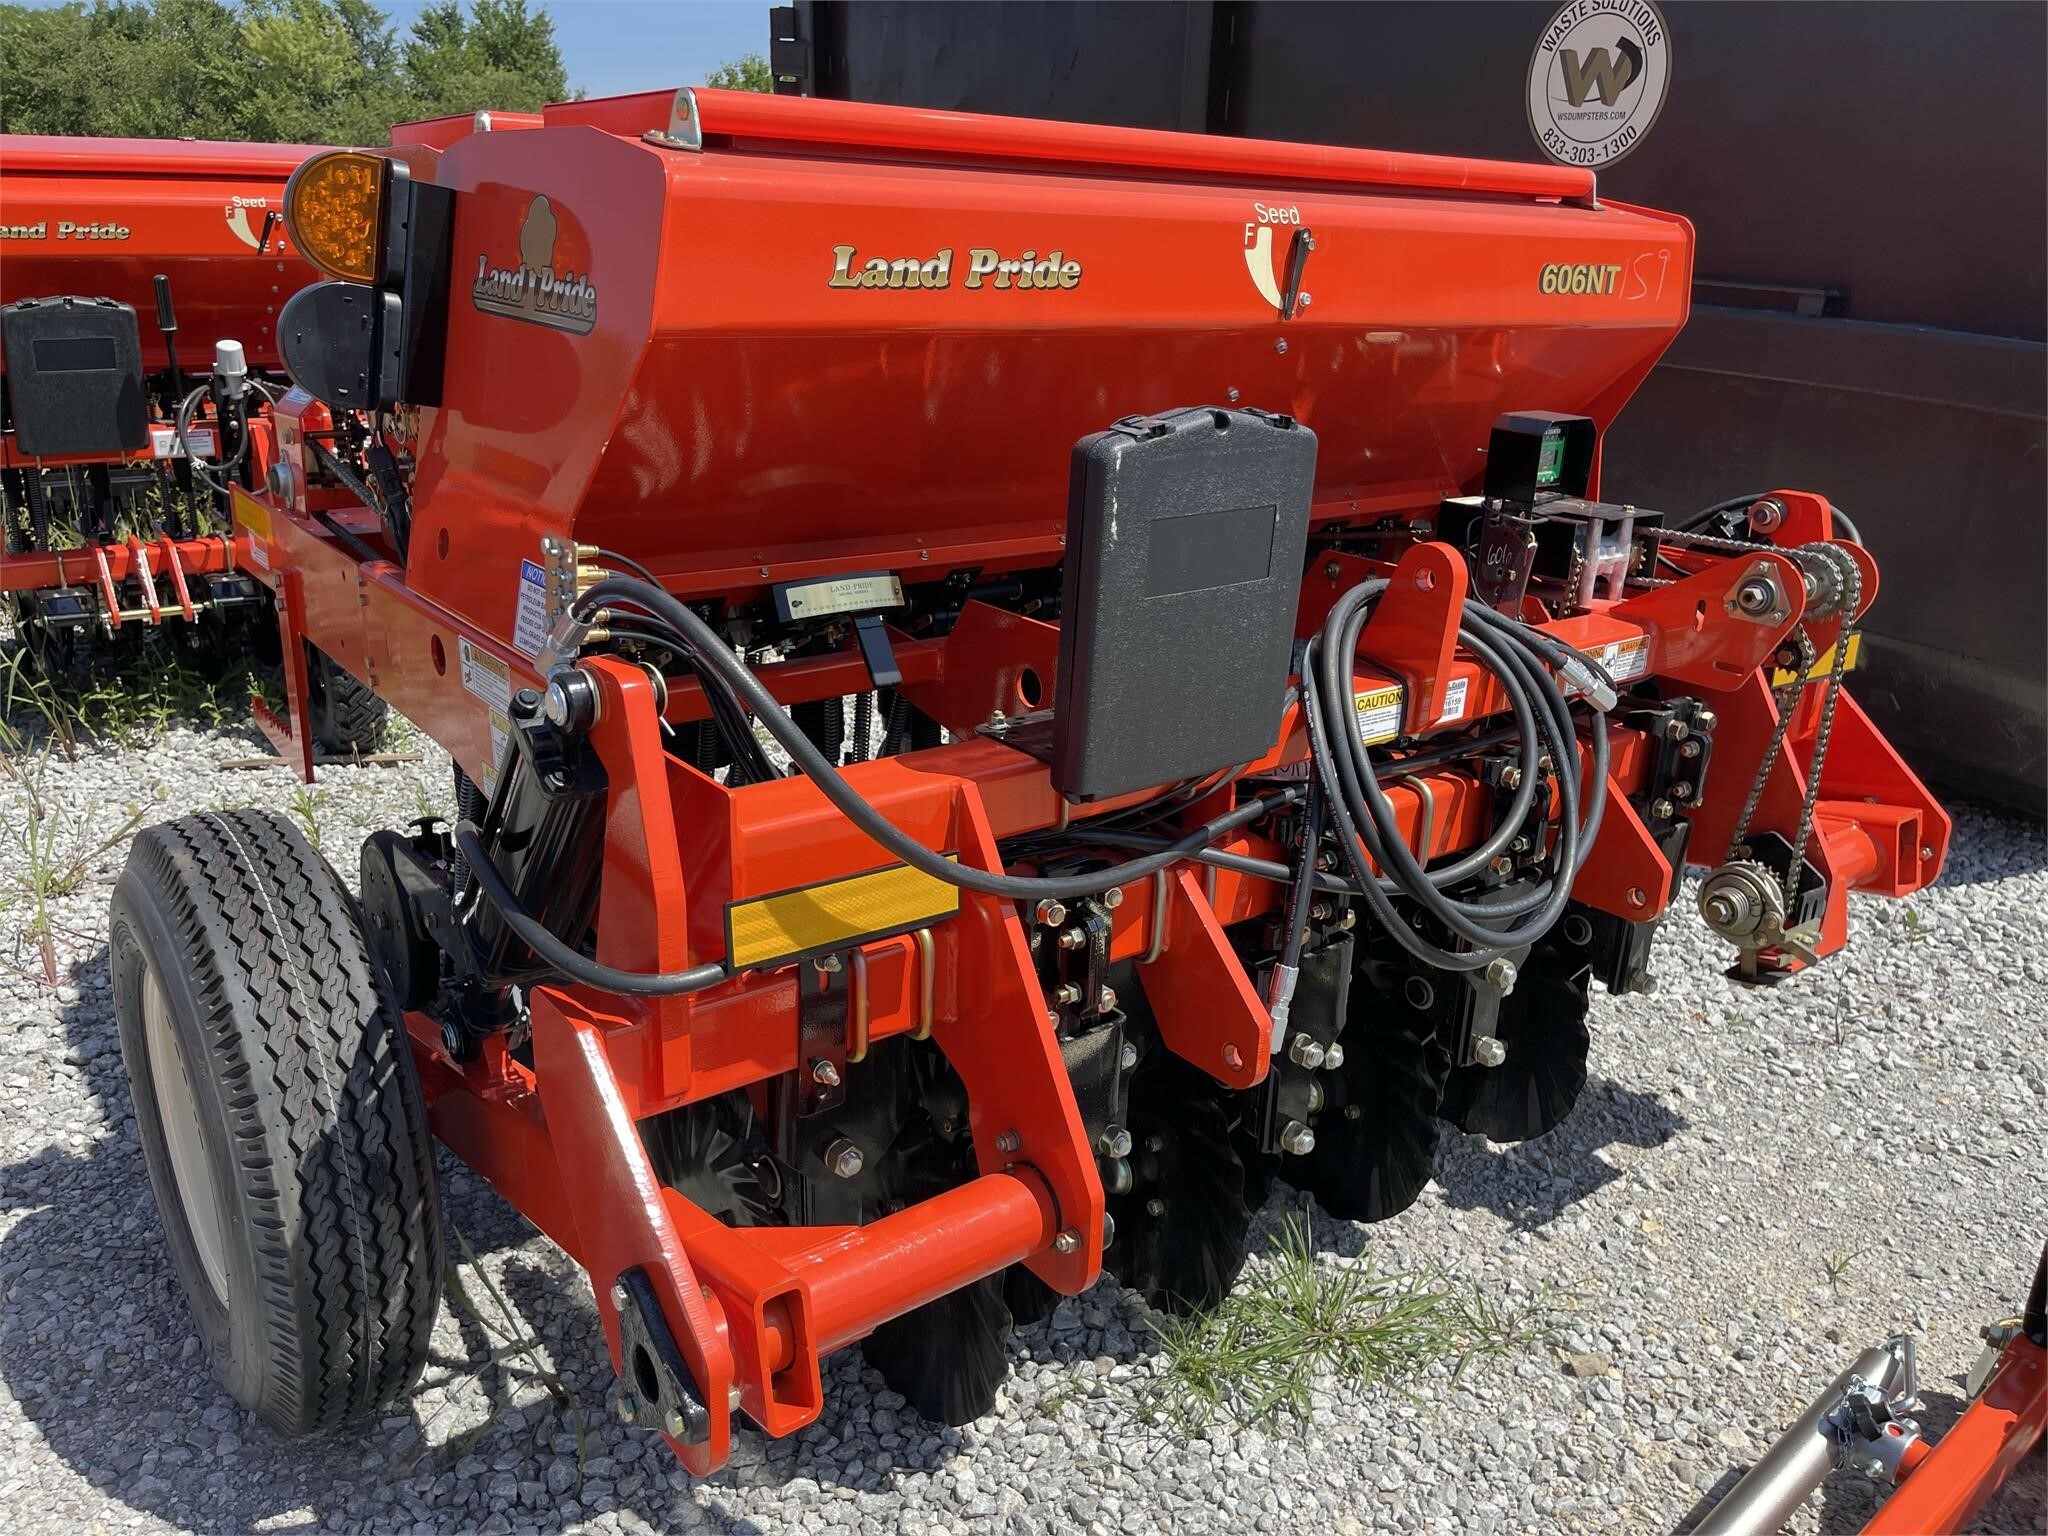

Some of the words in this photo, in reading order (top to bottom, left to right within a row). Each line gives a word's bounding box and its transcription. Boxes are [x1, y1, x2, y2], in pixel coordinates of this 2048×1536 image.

[1542, 1, 1588, 52] WASTE
[1592, 0, 1661, 47] SOLUTIONS
[1557, 111, 1626, 121] WSDUMPSTERS.COM
[1543, 125, 1637, 163] 833-303-1300
[225, 206, 232, 218] F
[232, 196, 267, 208] Seed
[1254, 202, 1300, 225] Seed
[0, 221, 48, 240] and
[56, 221, 131, 240] Pride
[1244, 222, 1255, 246] F
[827, 244, 953, 290] Land
[966, 248, 1083, 290] Pride
[474, 254, 527, 303] Land
[535, 265, 597, 318] Pride
[1539, 263, 1622, 295] 606NT
[526, 565, 547, 586] NOTIC
[830, 584, 851, 593] LAND
[853, 581, 874, 590] PRIDE
[1357, 691, 1404, 711] CAUTION
